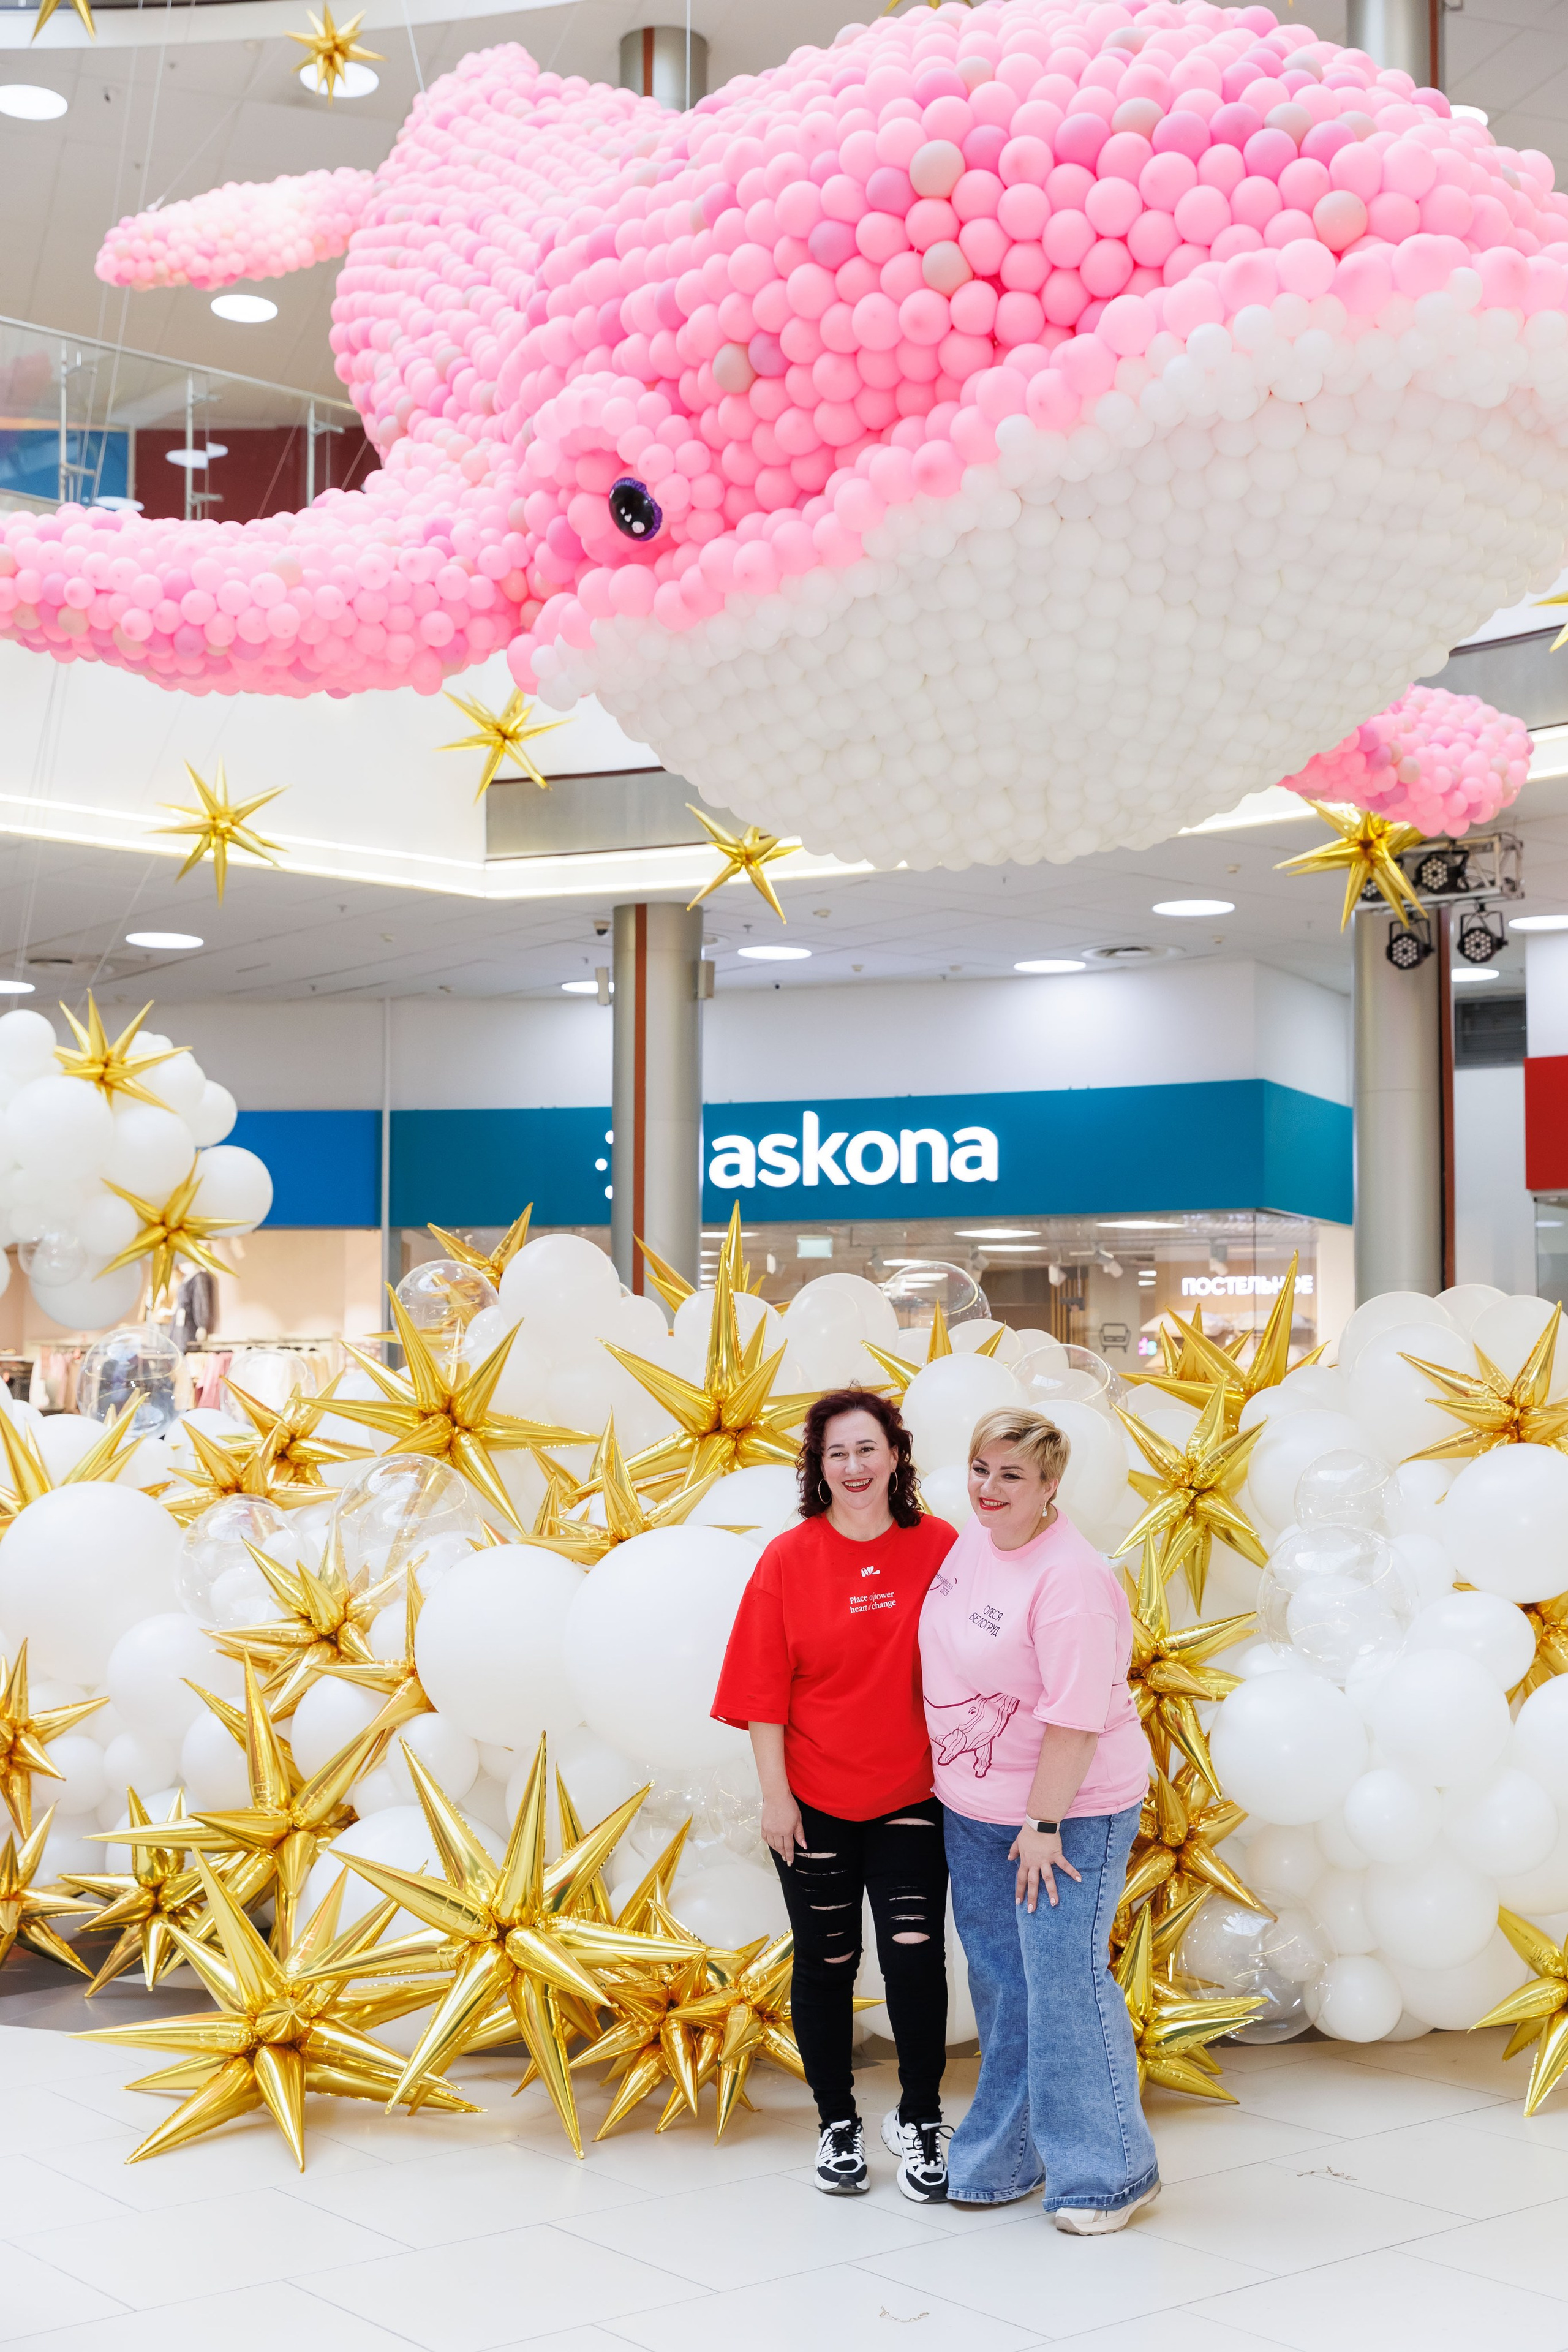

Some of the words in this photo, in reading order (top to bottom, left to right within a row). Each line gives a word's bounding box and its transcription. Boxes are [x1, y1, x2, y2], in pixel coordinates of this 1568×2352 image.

[709, 1110, 999, 1189] askona
[850, 1595, 868, 1604] Place
[873, 1592, 894, 1602] power
[850, 1605, 867, 1613] heart
[871, 1600, 896, 1608] change
[983, 1605, 1003, 1622] ОЛЕСЯ
[968, 1612, 1000, 1637] БЕЛОГРУД
